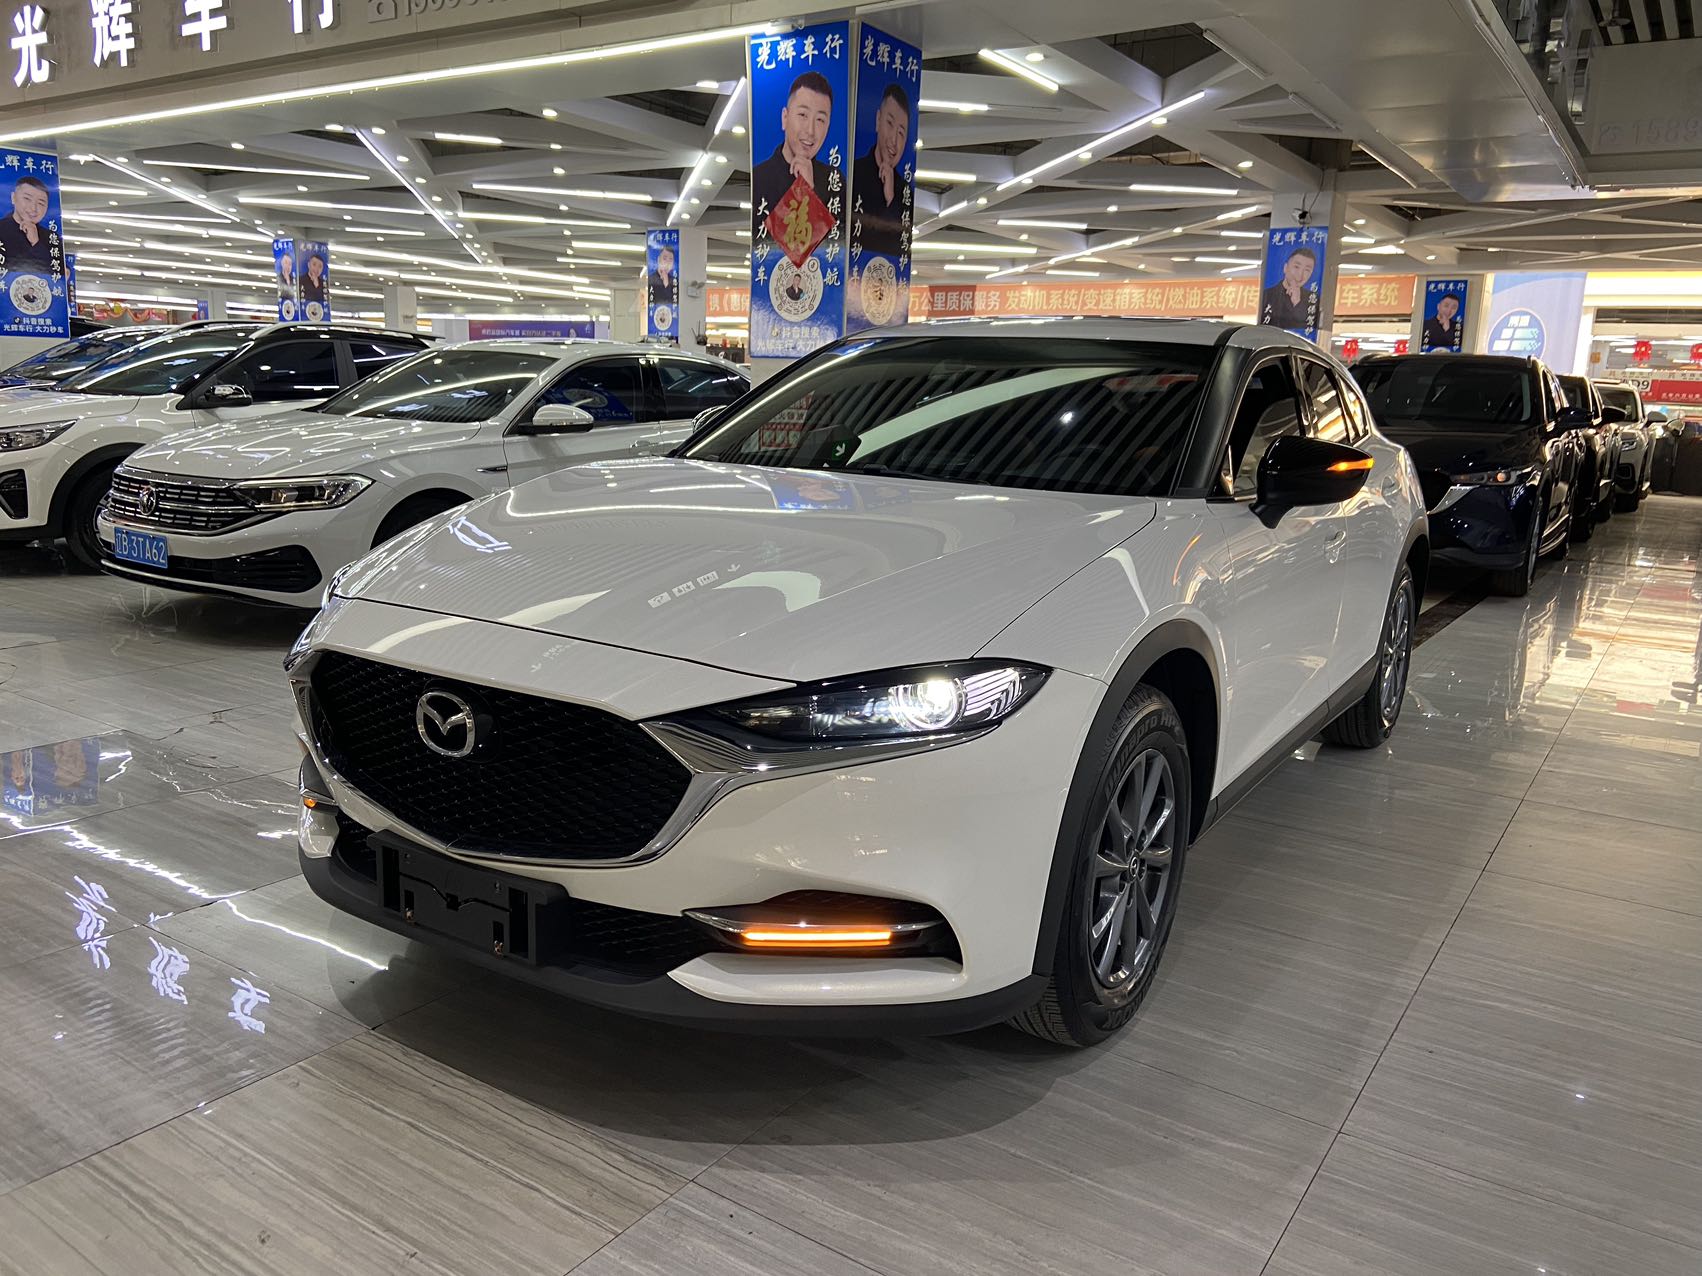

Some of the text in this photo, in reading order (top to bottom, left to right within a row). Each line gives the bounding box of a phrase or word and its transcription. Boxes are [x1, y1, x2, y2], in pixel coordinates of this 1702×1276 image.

[755, 33, 844, 70] 光辉车行
[863, 34, 919, 83] 光辉车行
[0, 154, 54, 175] 辉车行
[754, 196, 770, 287] 大力秒车
[1271, 231, 1325, 246] 光辉车行
